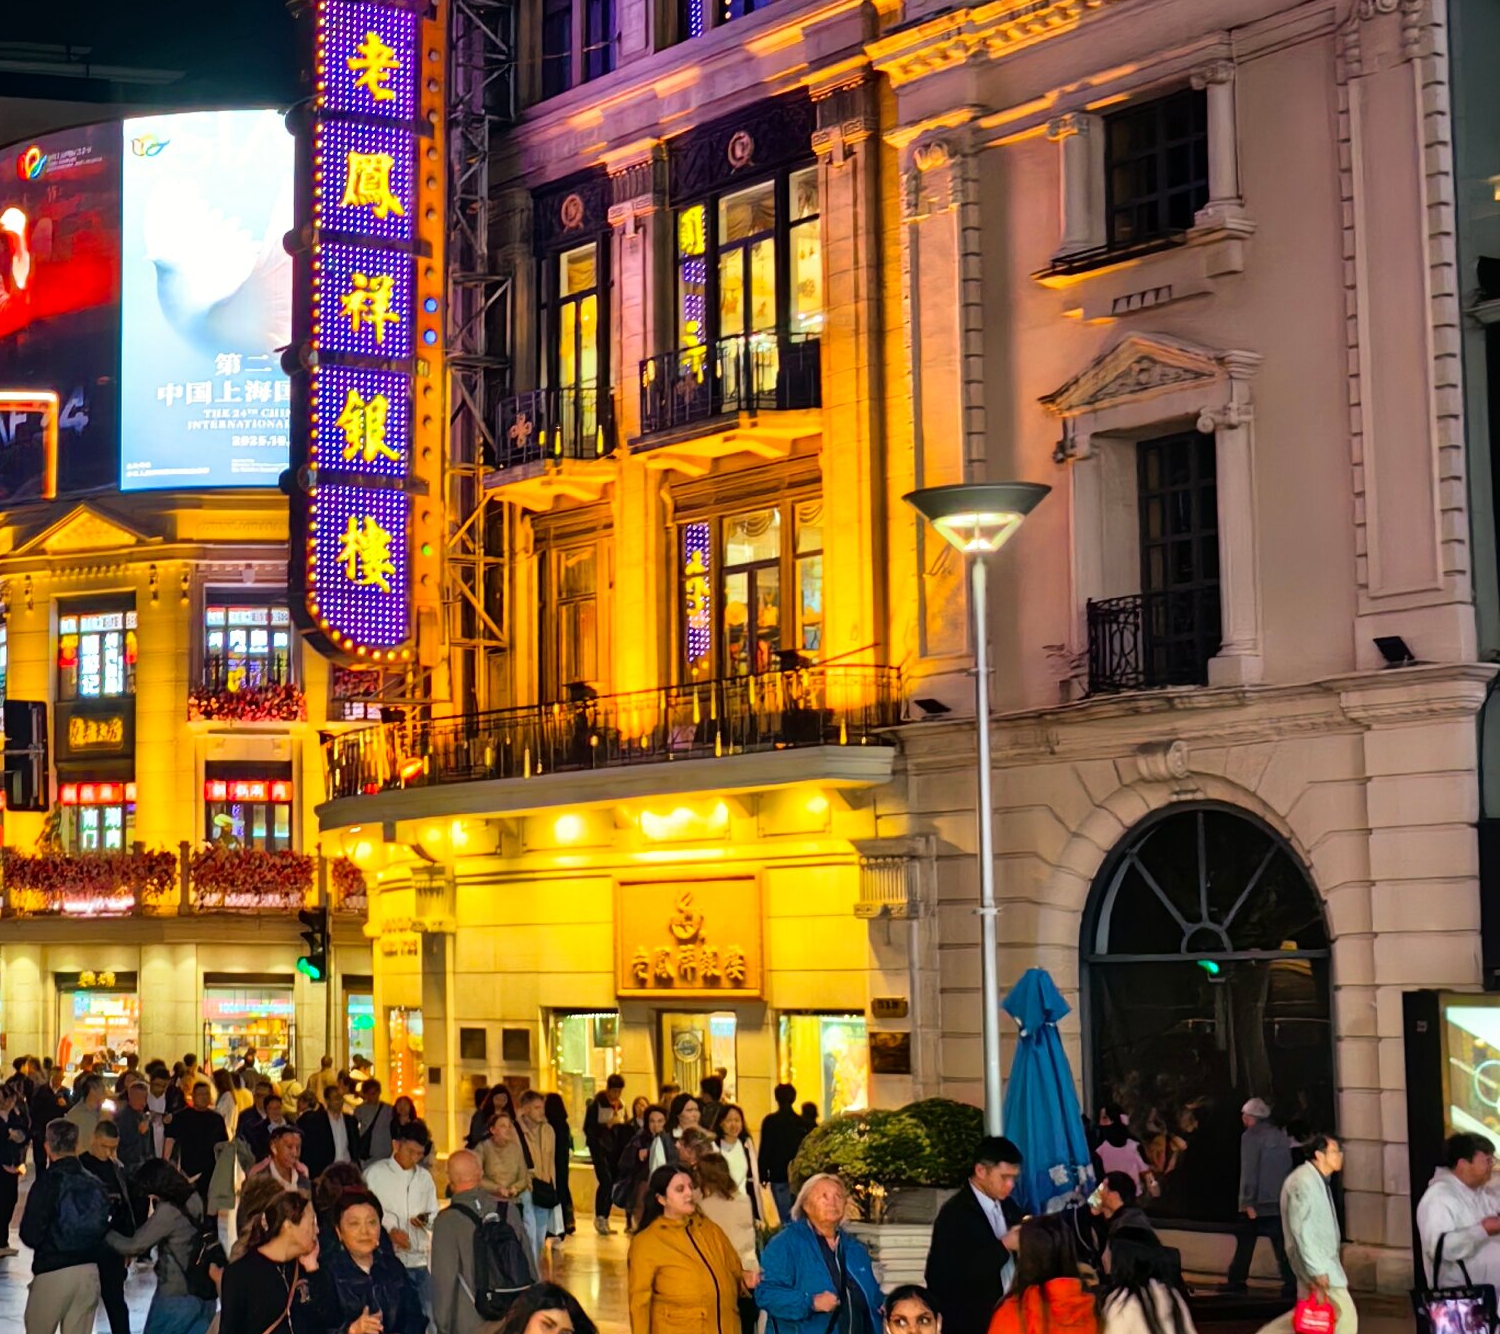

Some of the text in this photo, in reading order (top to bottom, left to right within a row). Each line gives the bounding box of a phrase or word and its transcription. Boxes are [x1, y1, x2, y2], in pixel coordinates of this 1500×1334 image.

[214, 352, 282, 376] 第二
[336, 31, 404, 593] 老鳳祥銀樓
